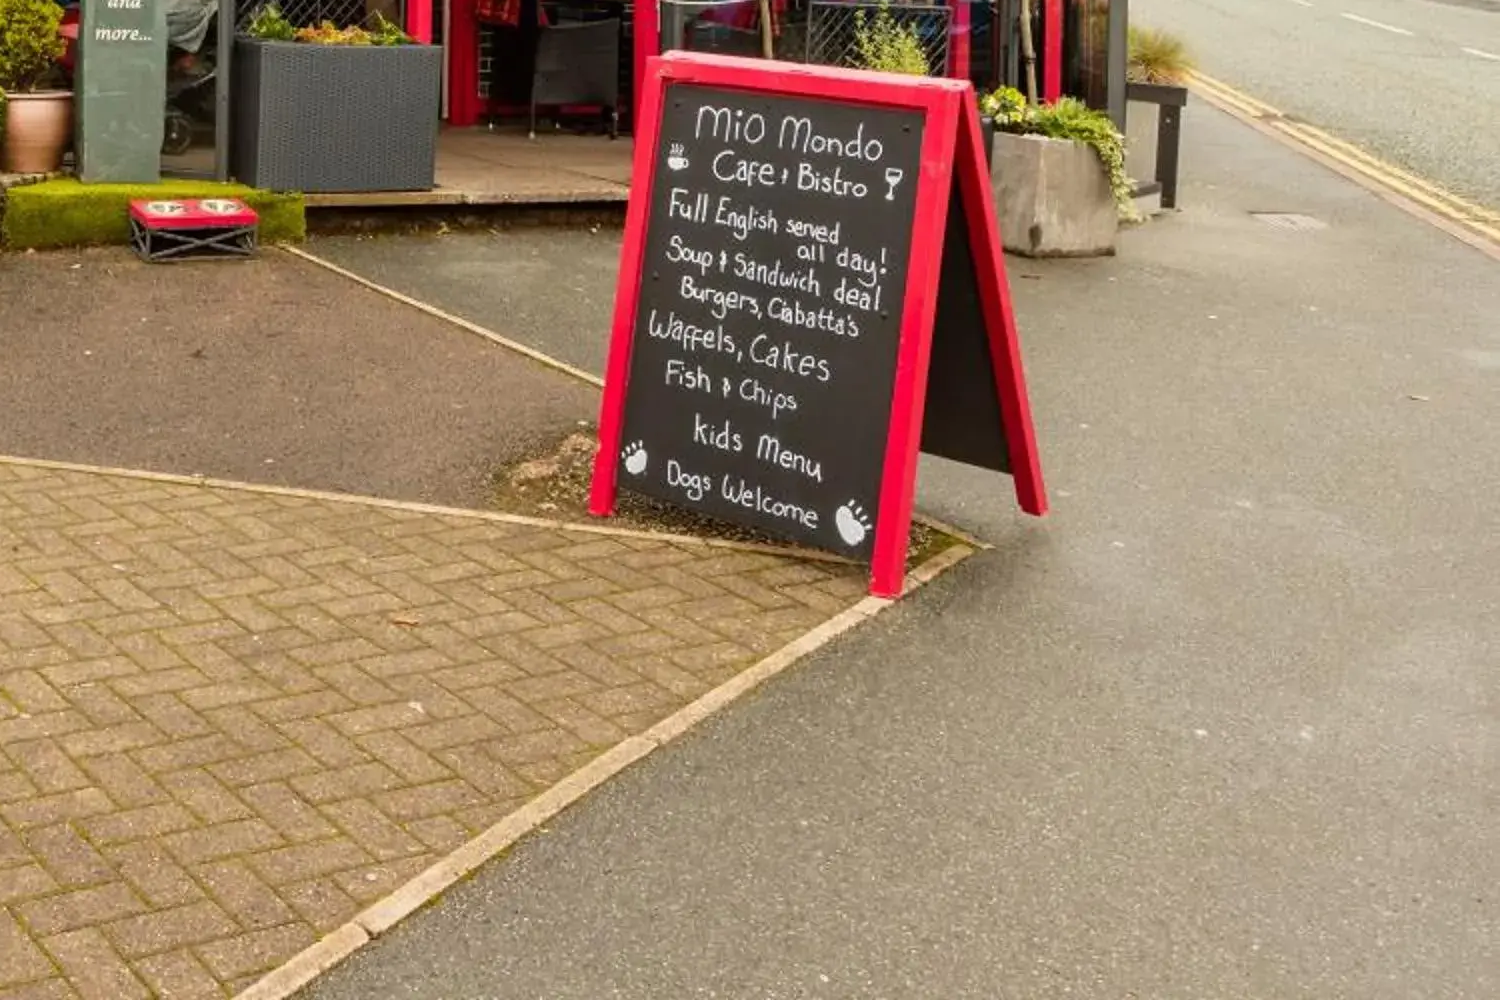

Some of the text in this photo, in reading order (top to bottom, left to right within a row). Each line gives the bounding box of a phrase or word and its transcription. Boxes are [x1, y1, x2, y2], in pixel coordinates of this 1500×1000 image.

[95, 25, 153, 42] more...
[778, 115, 884, 163] Mondo
[712, 150, 776, 188] Cafe
[797, 163, 868, 198] Bistro
[669, 188, 841, 245] Full English served
[665, 235, 714, 276] Soup
[733, 253, 821, 297] Sandwich
[833, 277, 882, 312] deal
[797, 244, 888, 287] all day!
[680, 275, 763, 321] Burgers,
[649, 309, 831, 382] Waffels, Cakes
[665, 359, 711, 393] Fish
[739, 379, 797, 420] Chips
[756, 434, 823, 483] Menu
[666, 459, 820, 529] Dogs Welcome
